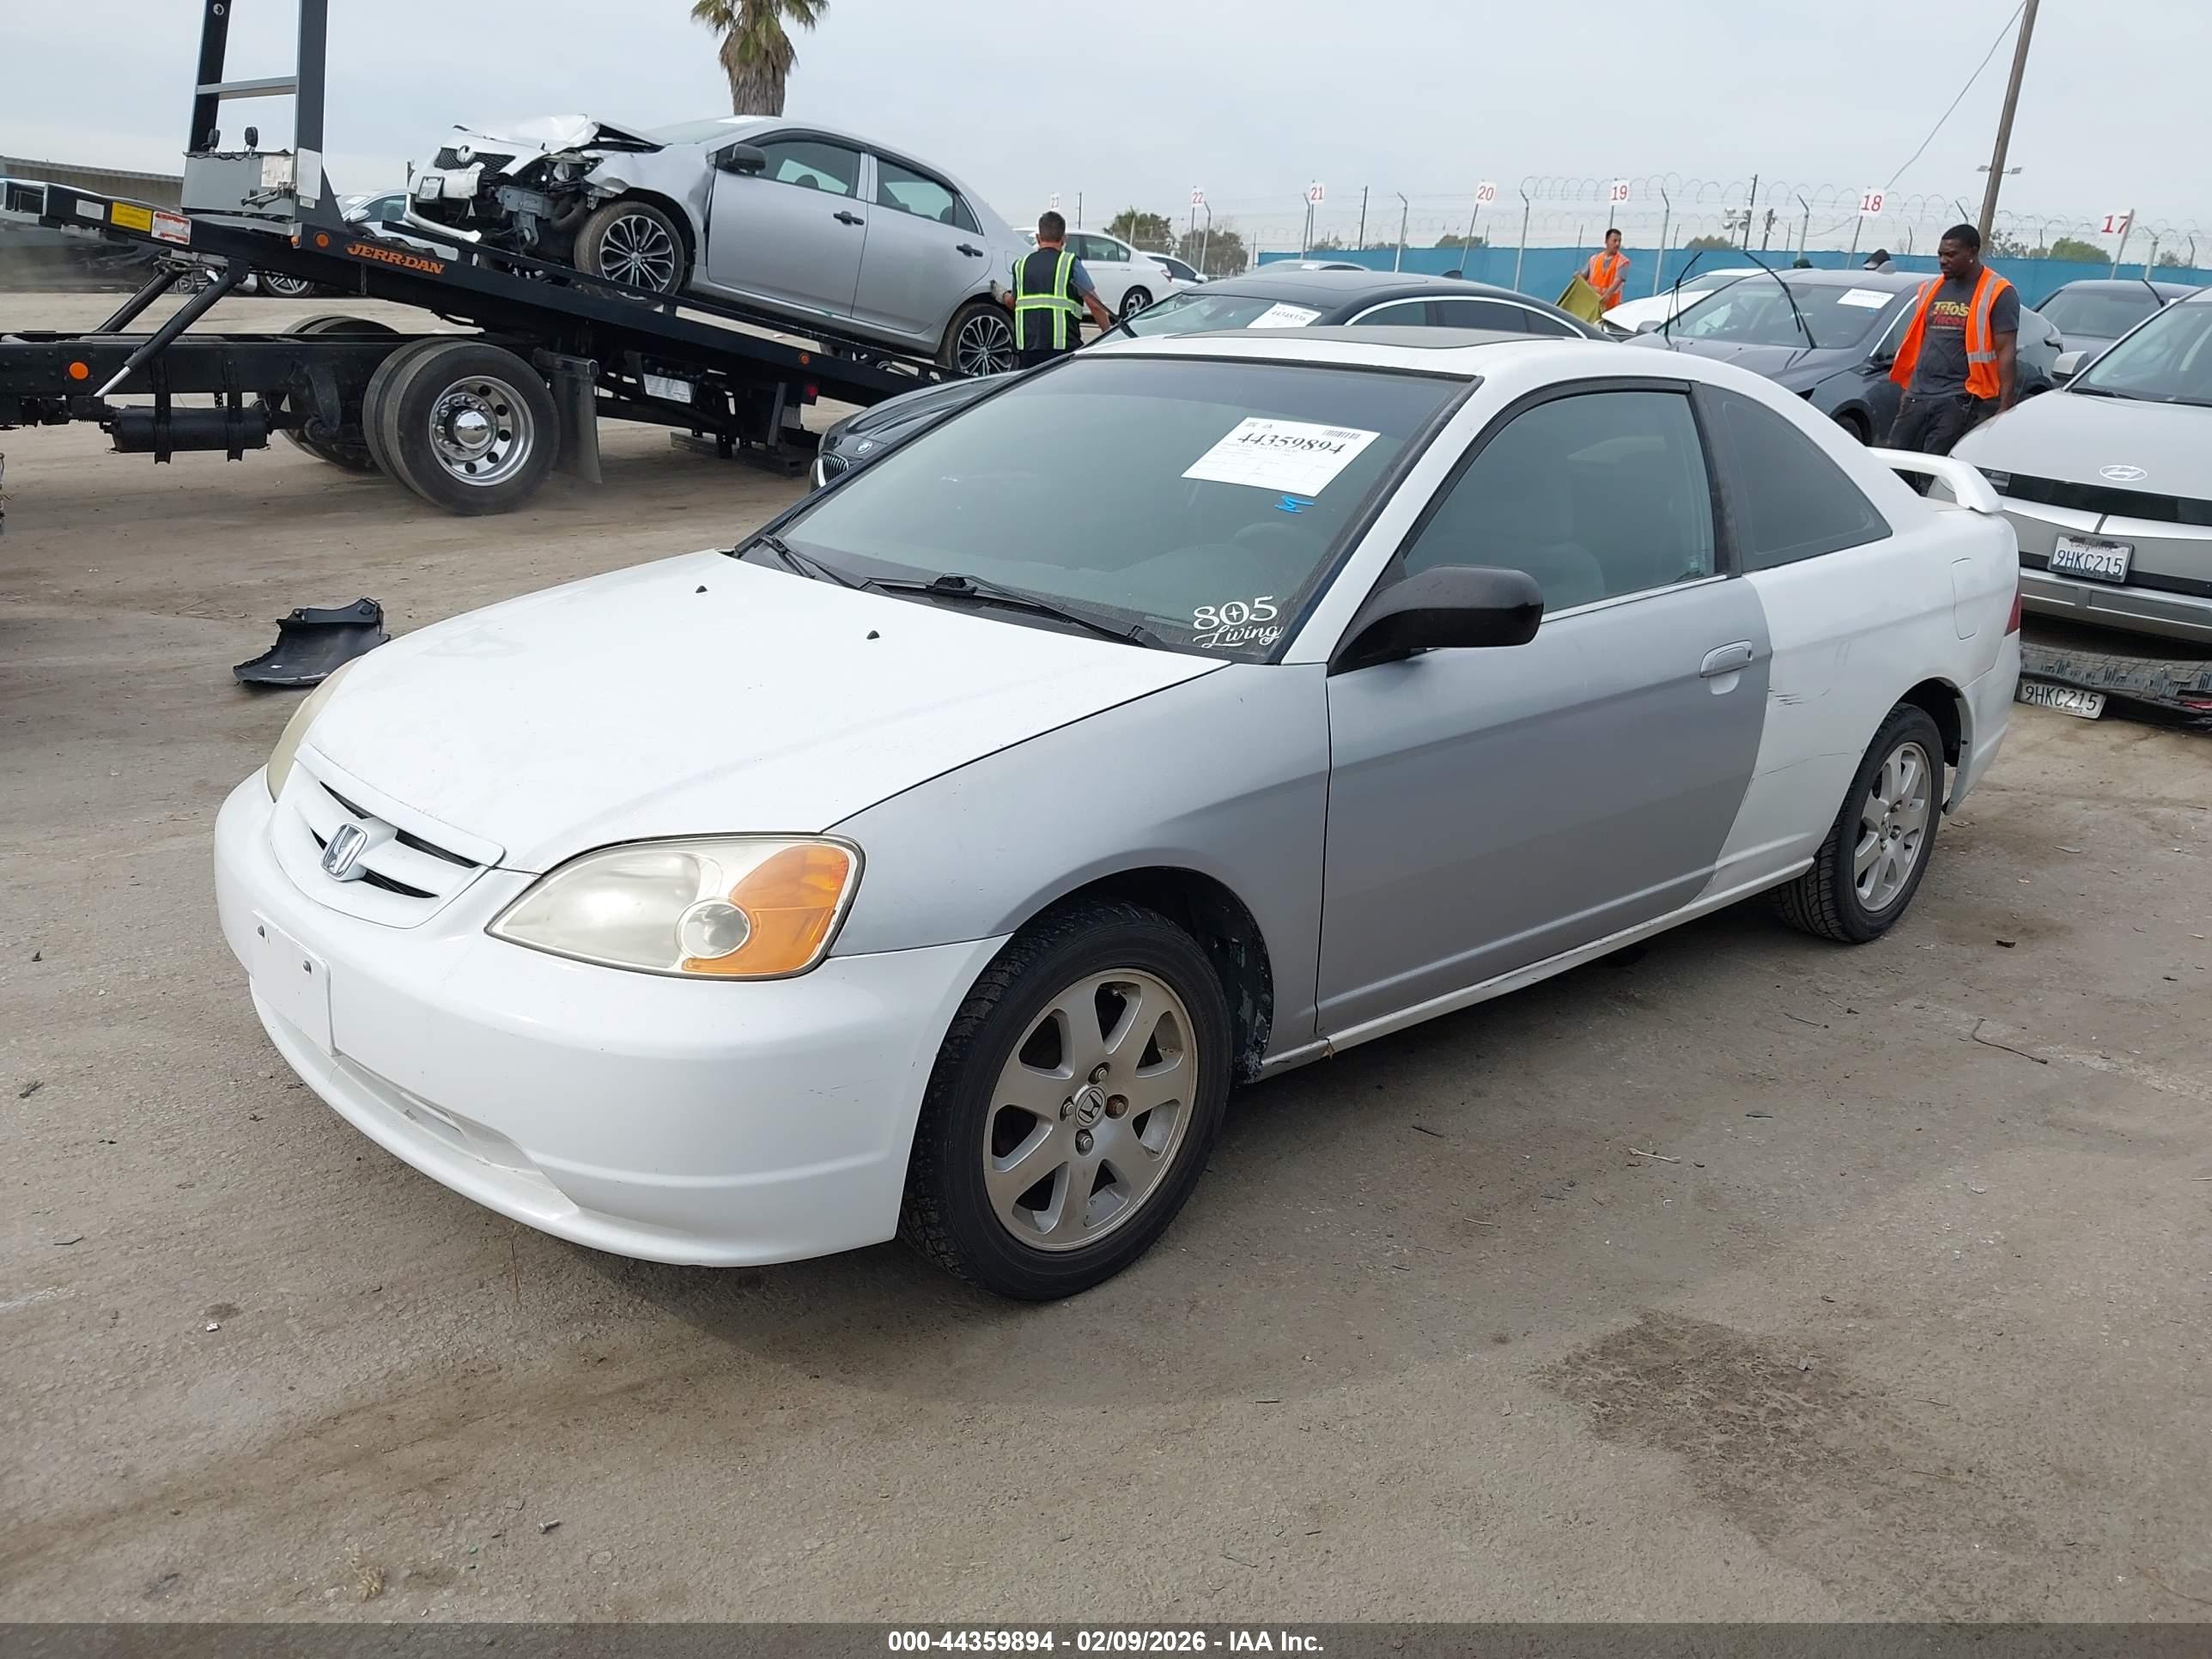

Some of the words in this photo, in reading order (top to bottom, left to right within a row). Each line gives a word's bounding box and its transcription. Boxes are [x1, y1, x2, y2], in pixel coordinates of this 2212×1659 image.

[1192, 191, 1204, 204] 22
[1310, 185, 1323, 200] 21
[1477, 185, 1495, 201] 20
[1611, 185, 1628, 201] 19
[1861, 194, 1882, 212] 18
[2101, 215, 2130, 234] 17
[1237, 432, 1346, 454] 44359894
[2057, 550, 2124, 575] 9HKC215
[1194, 595, 1278, 630] 805
[1193, 625, 1284, 649] Living
[2026, 686, 2099, 711] 9HKC215
